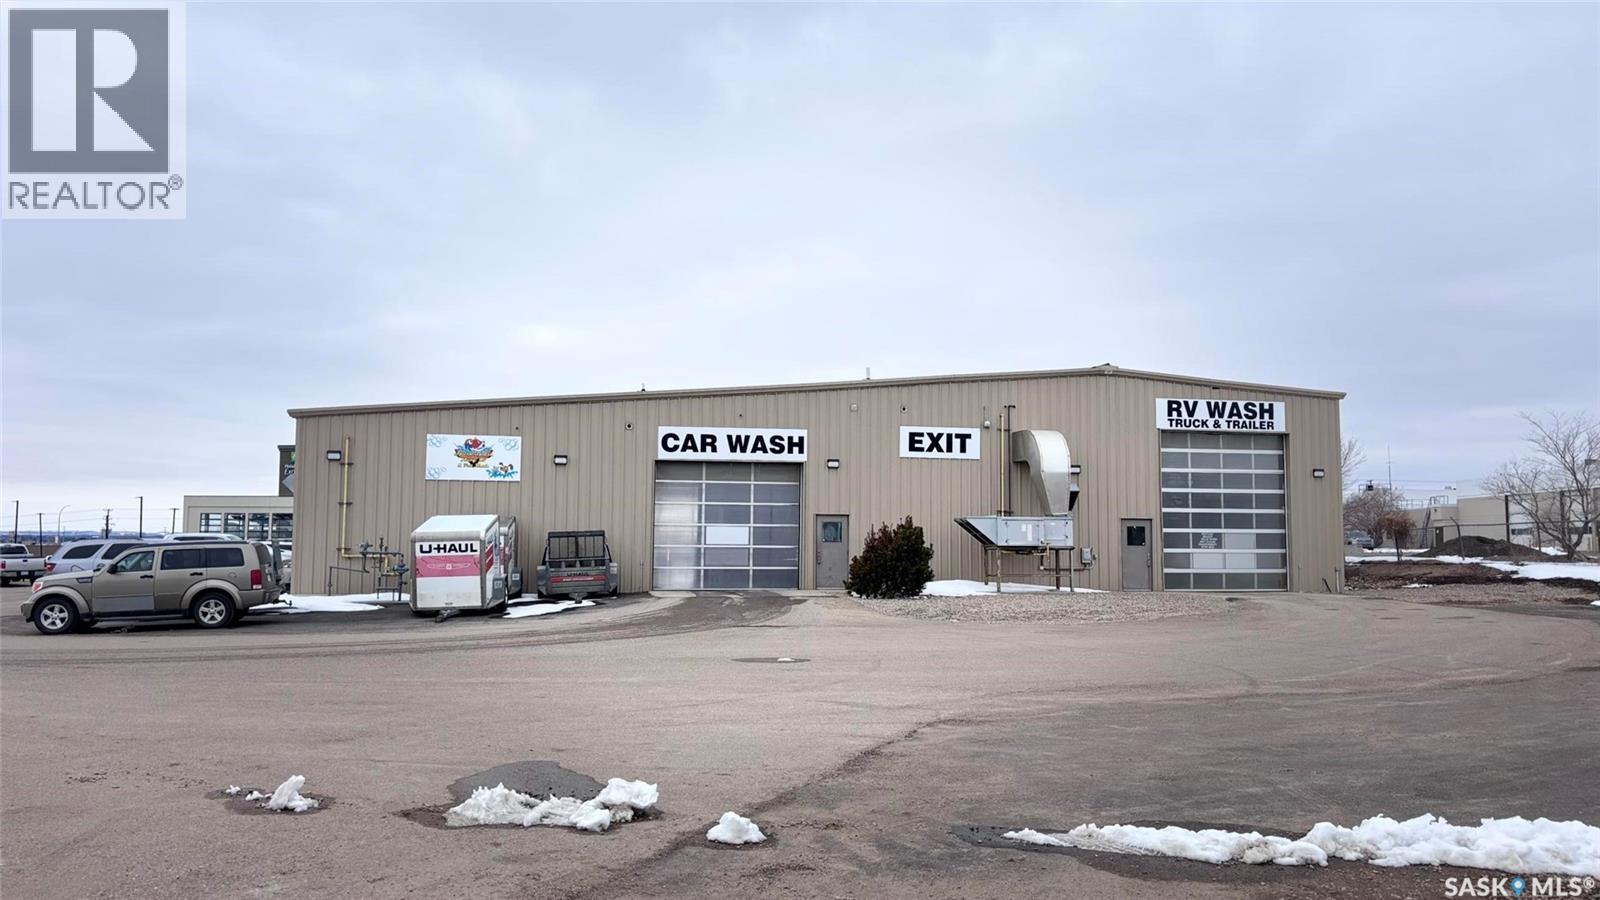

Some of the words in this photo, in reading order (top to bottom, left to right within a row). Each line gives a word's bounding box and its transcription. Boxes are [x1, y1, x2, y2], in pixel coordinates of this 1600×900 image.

[1167, 400, 1198, 417] RV
[1206, 401, 1274, 420] WASH
[1168, 418, 1209, 428] TRUCK
[1213, 419, 1221, 428] &
[1225, 420, 1274, 430] TRAILER
[661, 433, 717, 453] CAR
[727, 434, 804, 454] WASH
[908, 432, 972, 453] EXIT
[420, 543, 478, 553] U-HAUL
